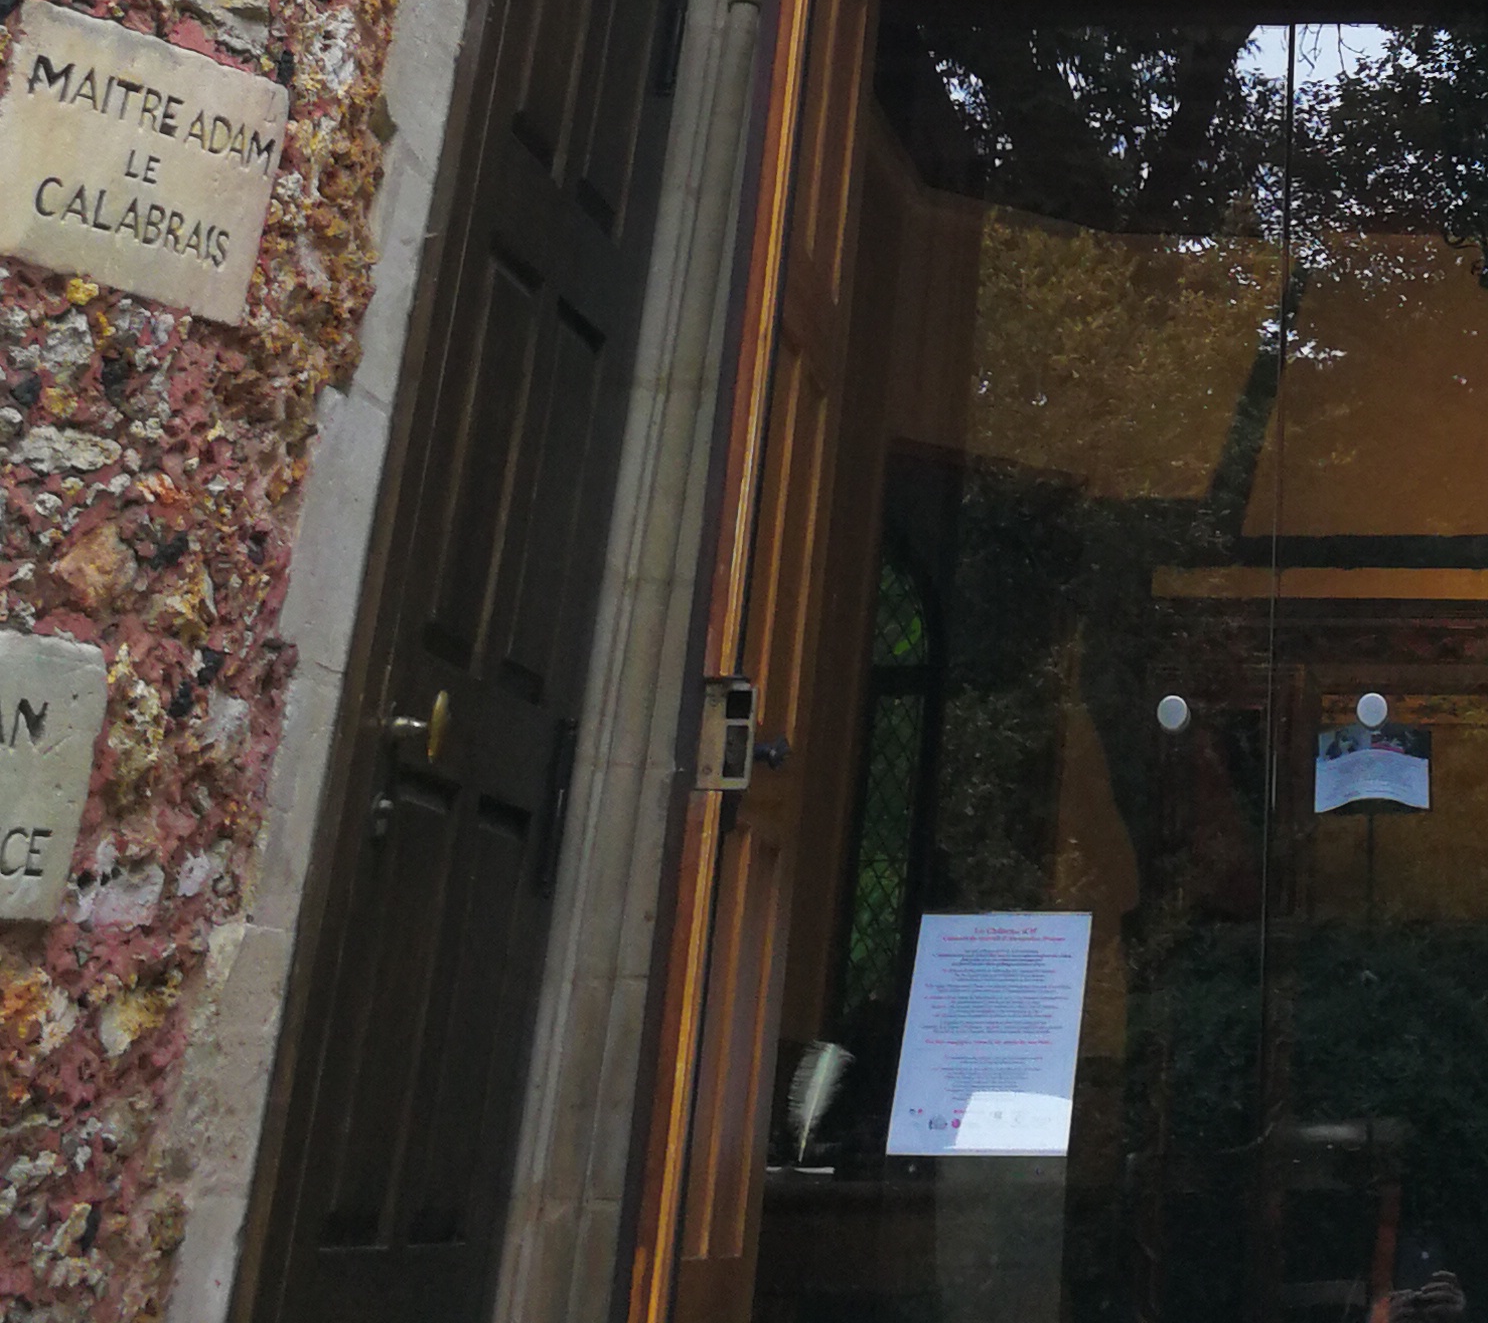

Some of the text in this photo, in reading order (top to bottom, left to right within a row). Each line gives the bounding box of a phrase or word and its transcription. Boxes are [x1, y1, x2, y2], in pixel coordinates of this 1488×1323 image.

[27, 54, 277, 177] MAITRE ADAM
[124, 149, 162, 185] LE
[34, 176, 232, 269] CALABRAIS
